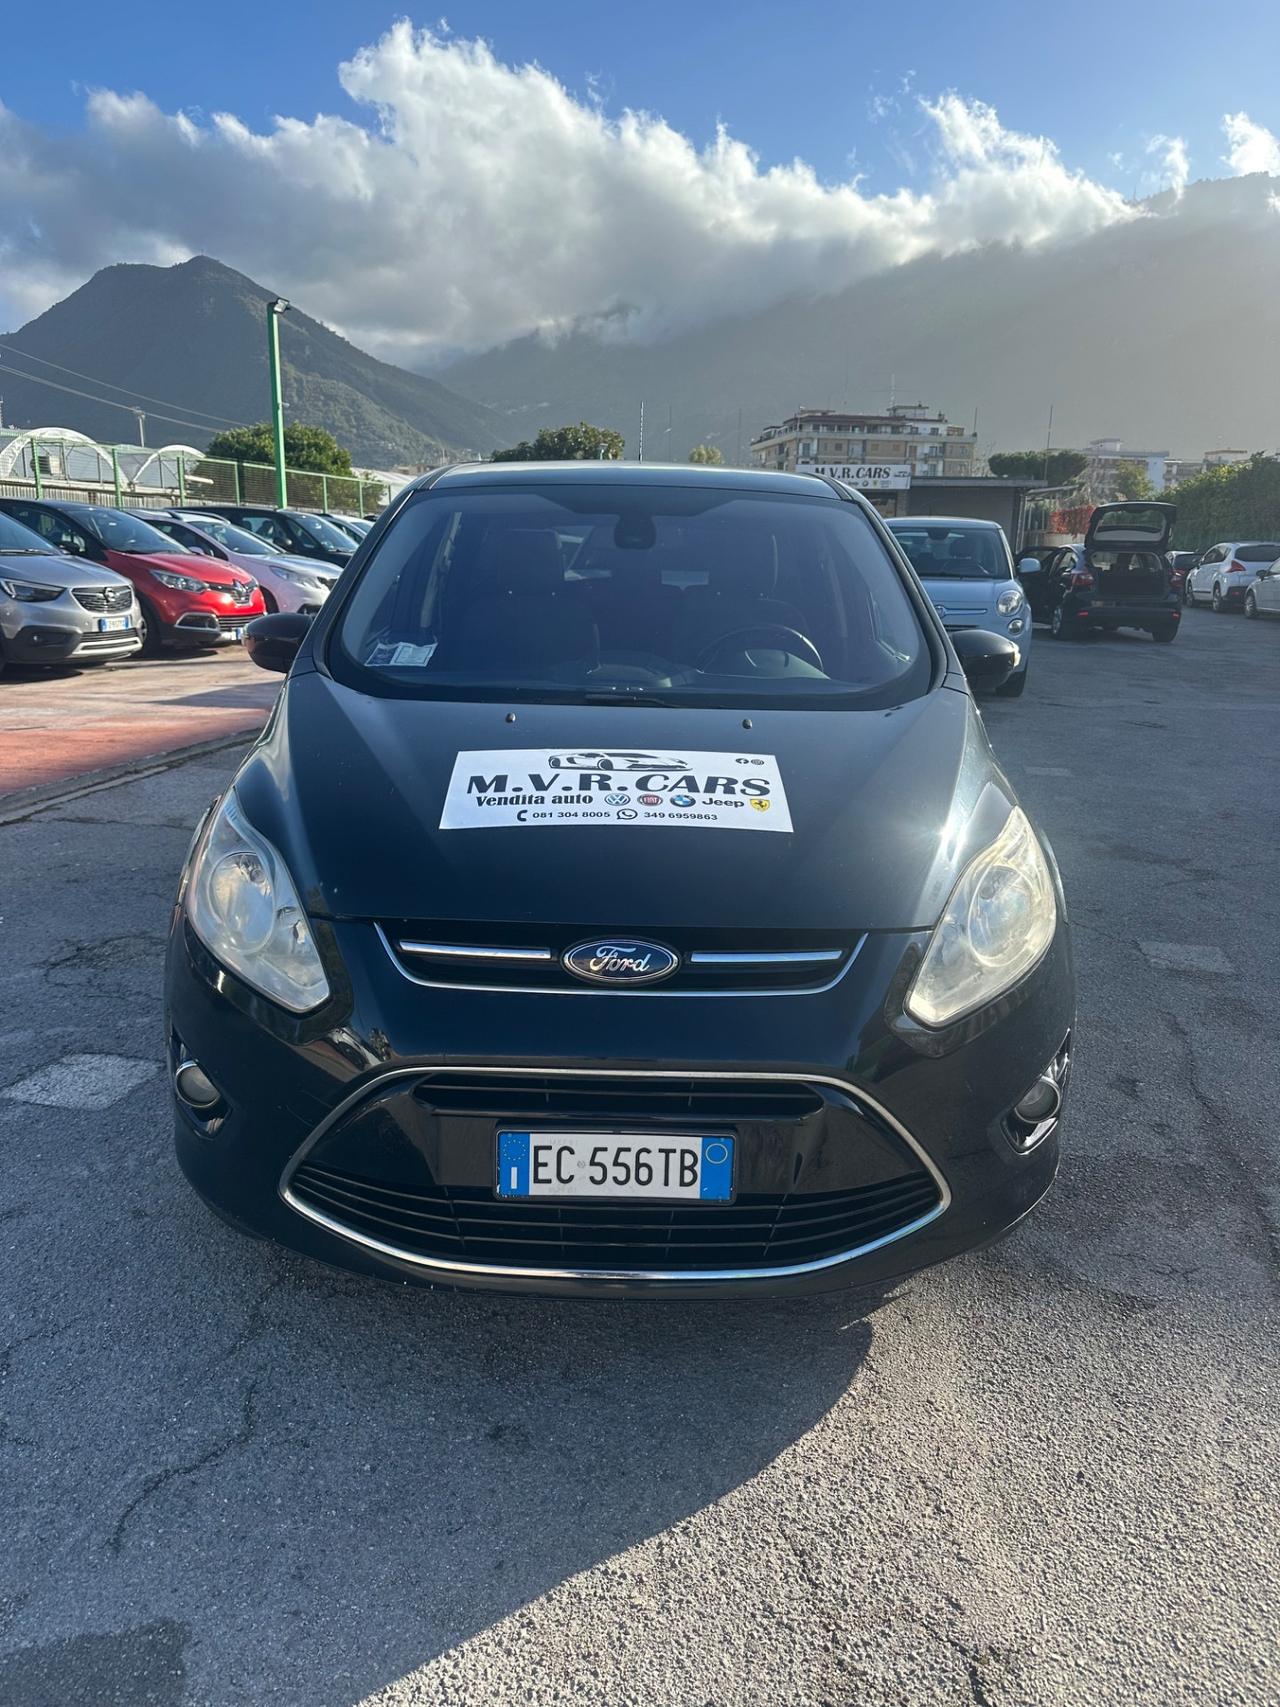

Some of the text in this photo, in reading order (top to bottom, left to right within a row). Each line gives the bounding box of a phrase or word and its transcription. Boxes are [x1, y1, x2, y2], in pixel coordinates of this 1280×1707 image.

[551, 793, 594, 804] auto
[702, 797, 745, 808] Jeep
[532, 811, 554, 819] 081
[643, 811, 718, 820] 349 6959863
[589, 945, 652, 972] Ford
[533, 1145, 699, 1188] EC 556TB
